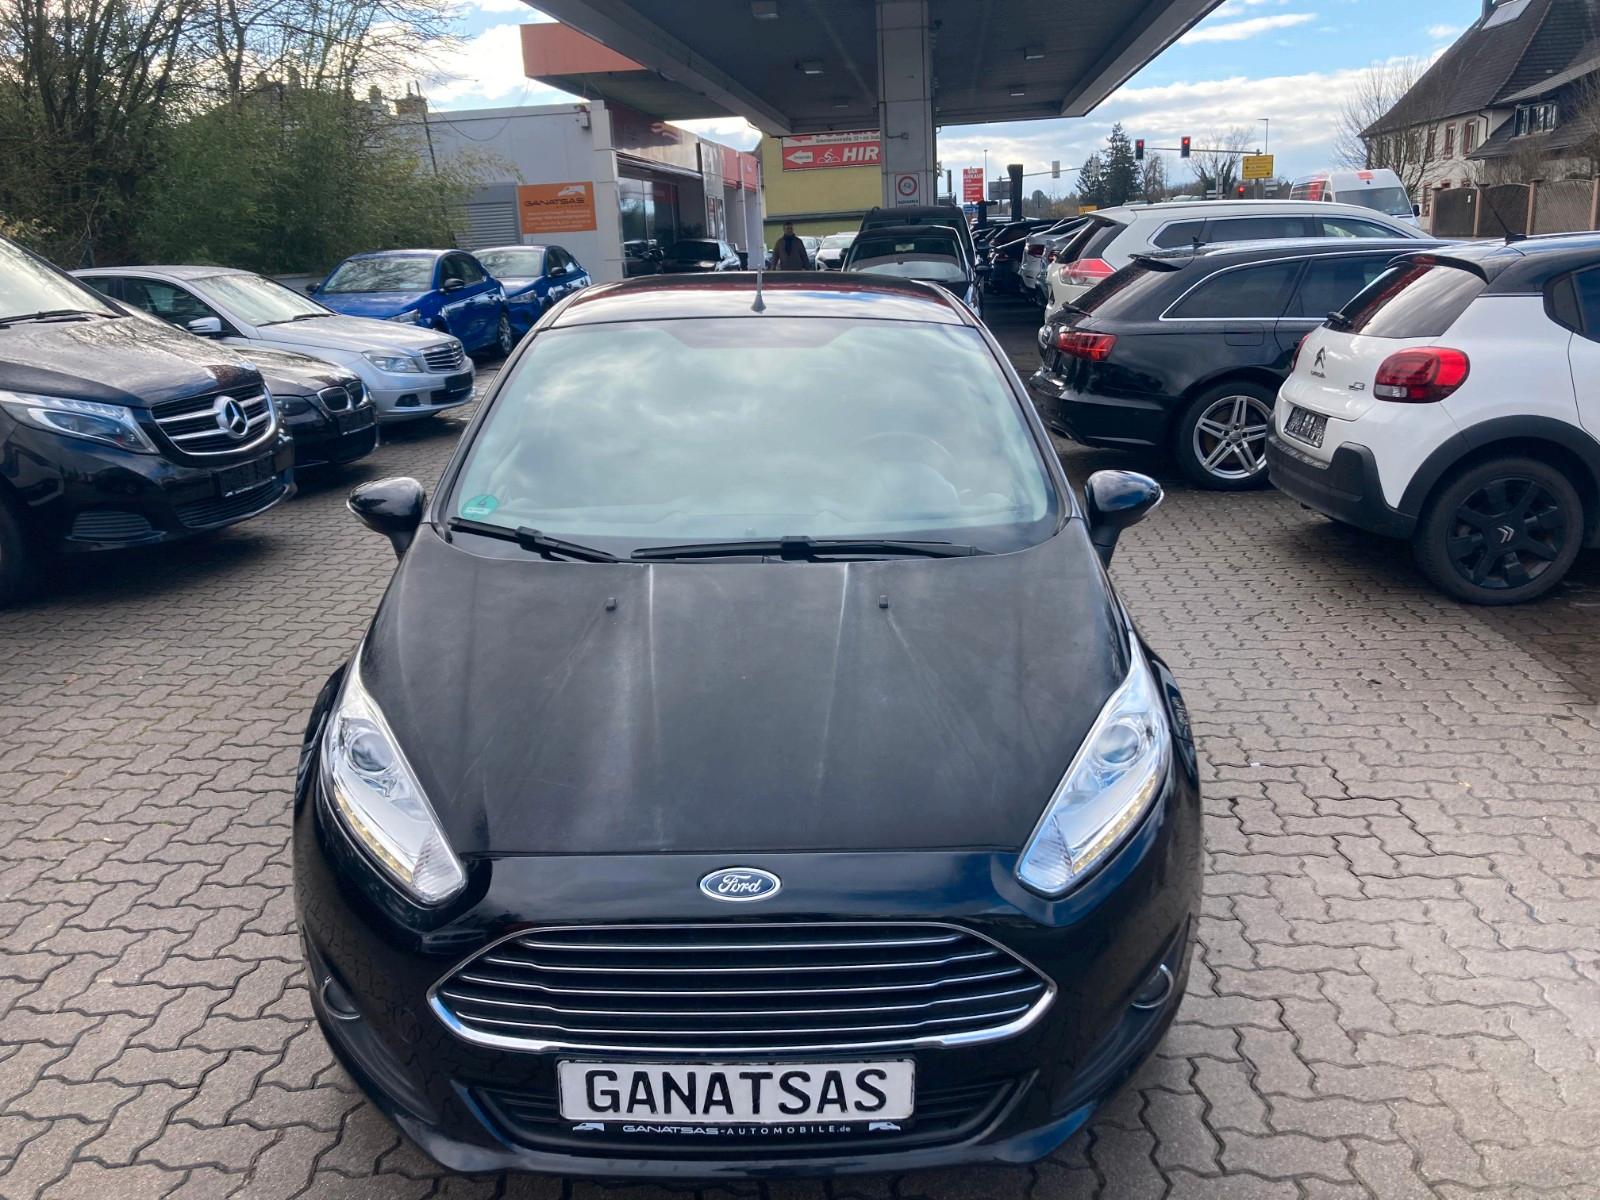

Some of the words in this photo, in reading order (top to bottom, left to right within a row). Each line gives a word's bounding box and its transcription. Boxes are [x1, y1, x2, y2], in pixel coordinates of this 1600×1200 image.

[842, 146, 880, 162] HIR
[525, 197, 585, 207] GANATSAS
[718, 874, 762, 893] Ford
[585, 1069, 888, 1115] GANATSAS
